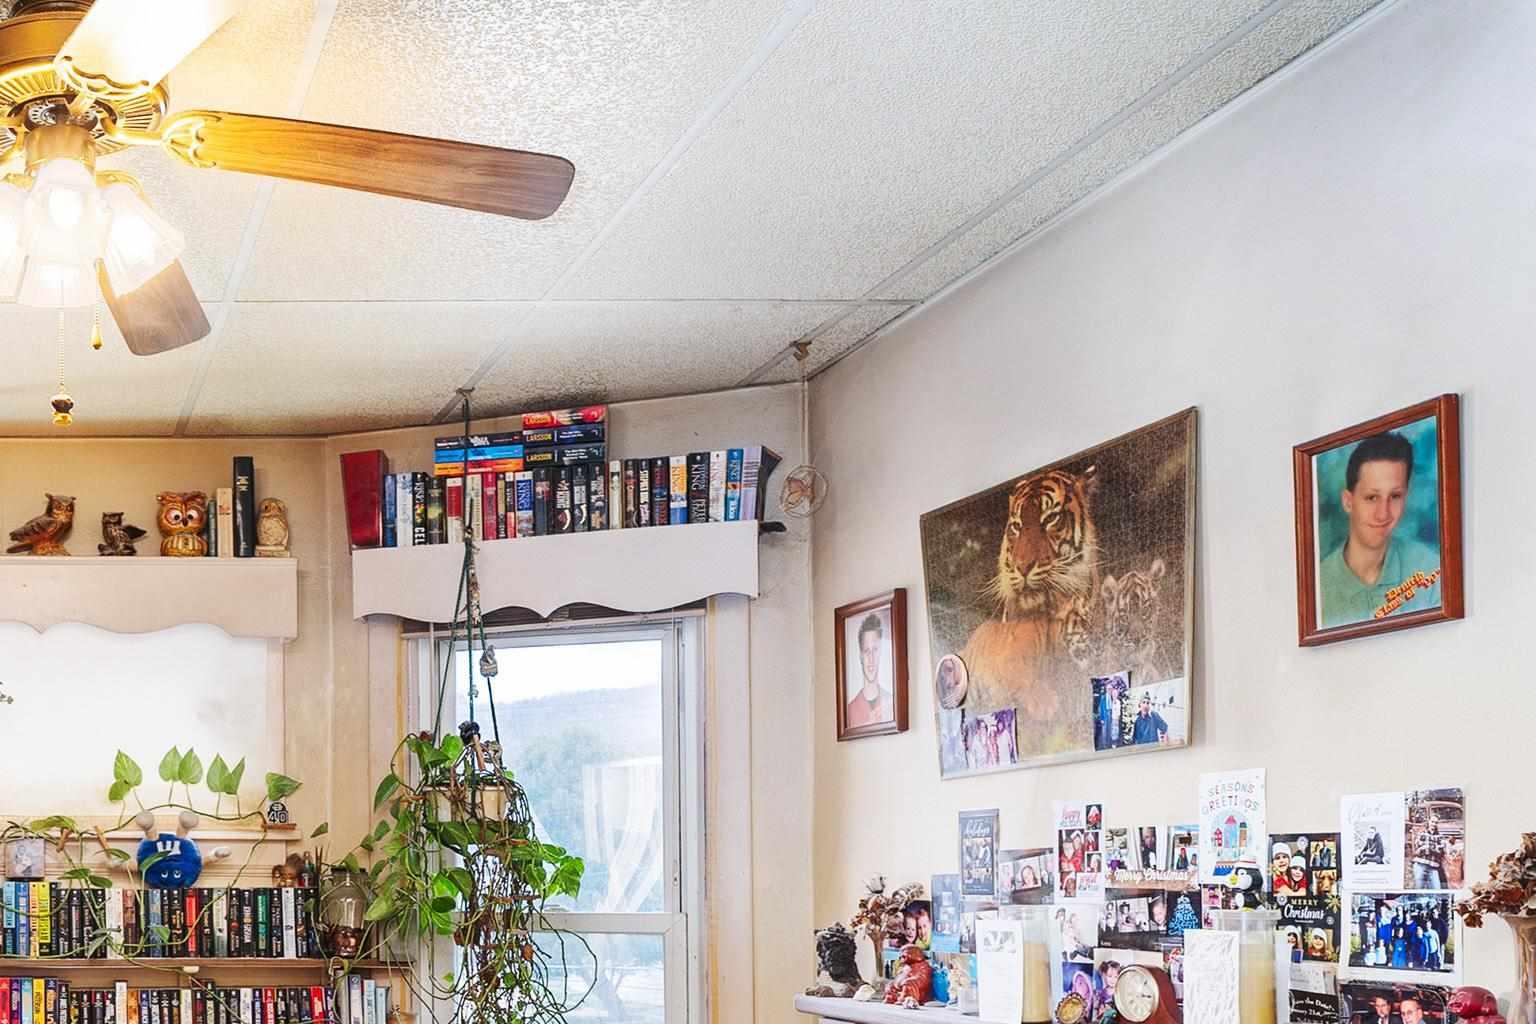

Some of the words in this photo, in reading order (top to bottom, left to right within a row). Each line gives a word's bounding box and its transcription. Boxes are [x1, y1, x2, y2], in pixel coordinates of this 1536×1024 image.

[692, 464, 702, 490] KING
[517, 482, 527, 509] KING
[1207, 781, 1255, 798] SEASONS
[1201, 795, 1260, 816] GREETINGS
[1115, 869, 1142, 884] Merry
[1143, 867, 1189, 881] Christmas
[1291, 898, 1319, 906] MERRY
[1284, 903, 1325, 921] Christmas
